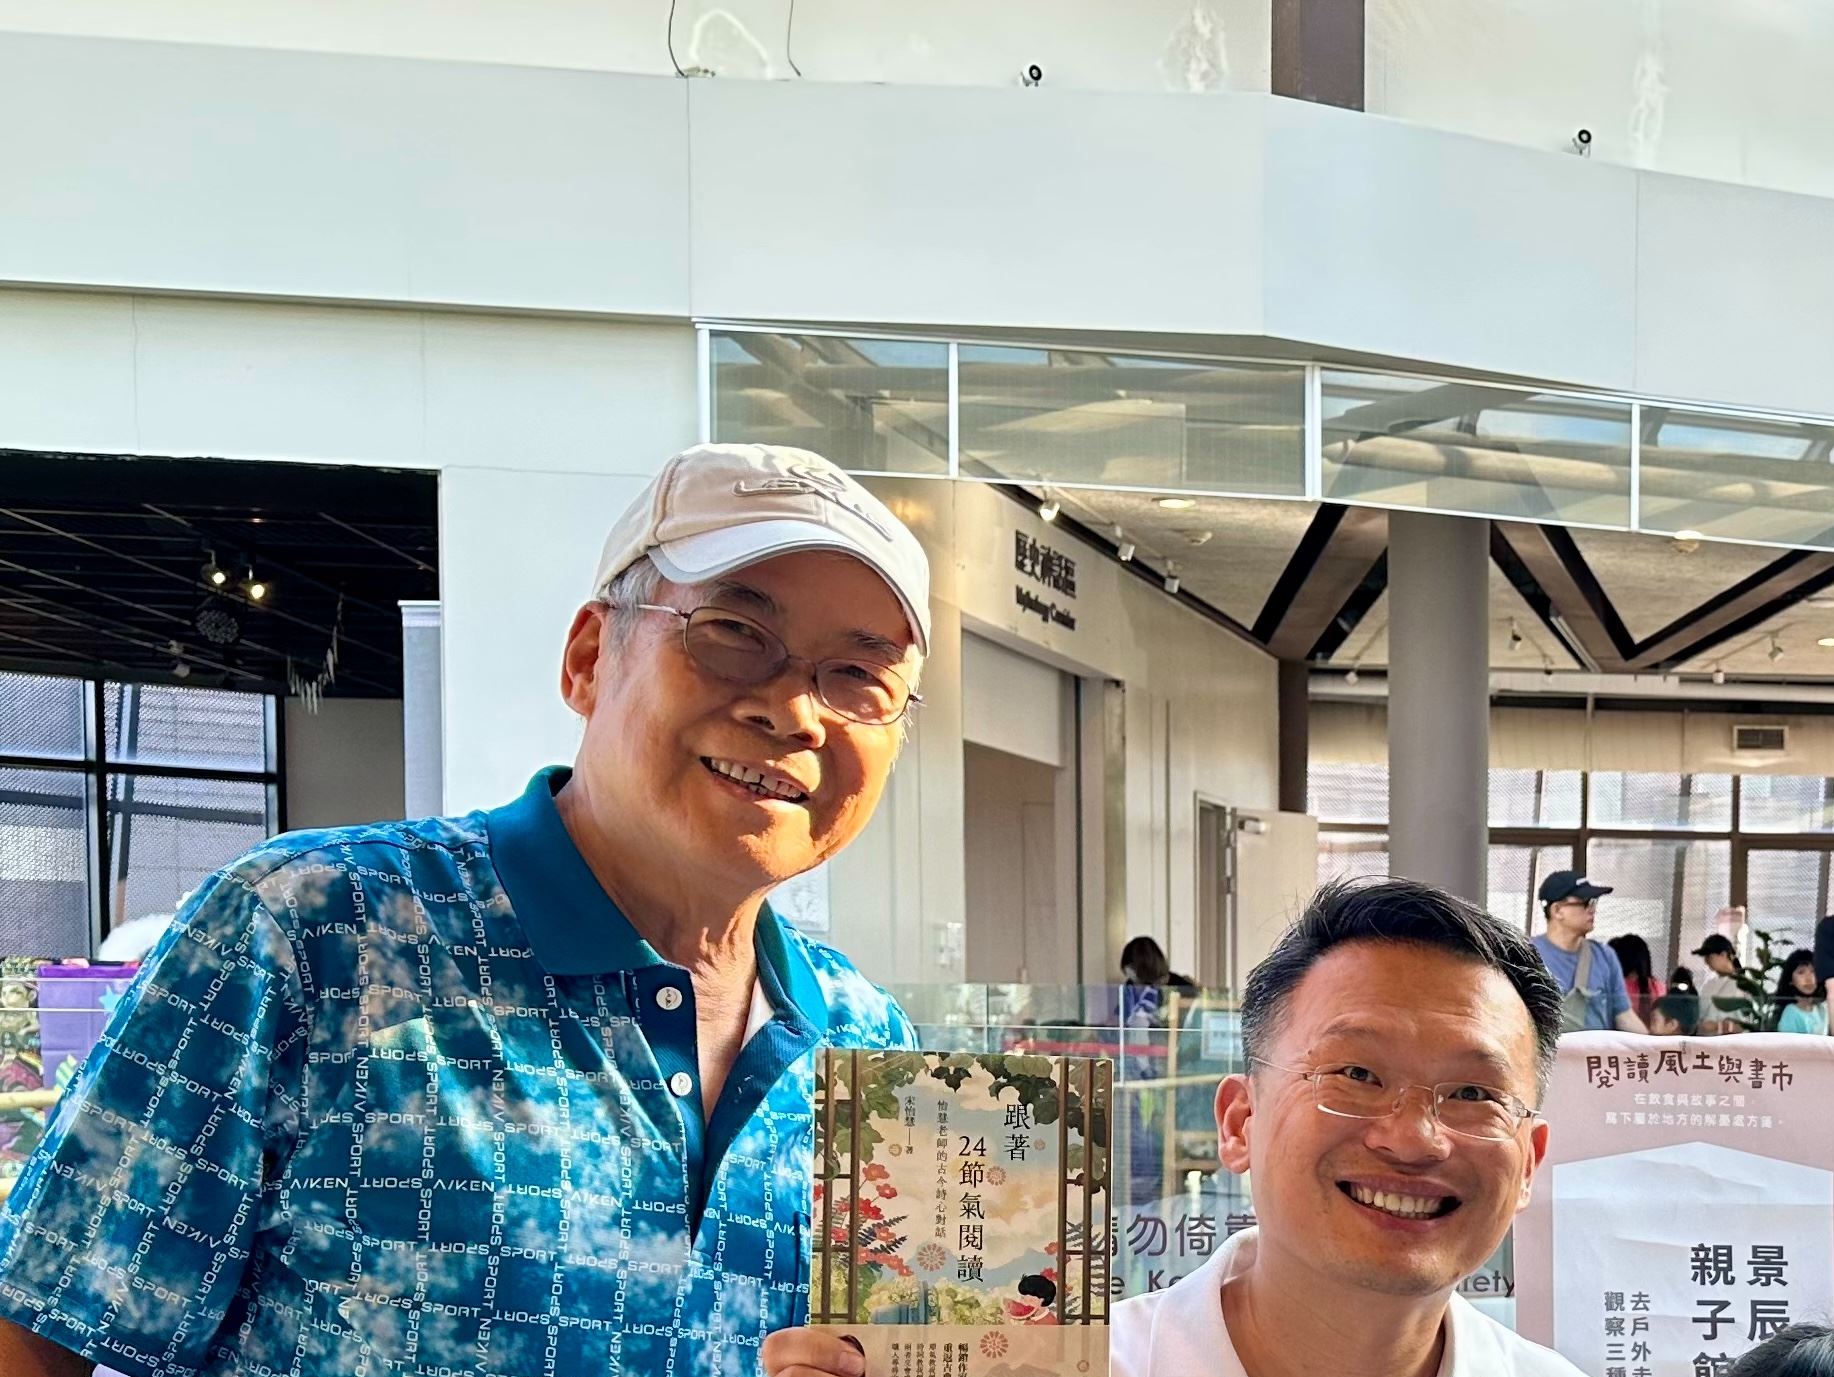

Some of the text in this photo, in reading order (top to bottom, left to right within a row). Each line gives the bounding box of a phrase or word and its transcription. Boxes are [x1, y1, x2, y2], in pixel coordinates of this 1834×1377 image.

[357, 866, 411, 884] SPORT
[349, 871, 366, 923] SPORT
[368, 924, 418, 944] SPORT
[470, 902, 487, 951] SPORT
[417, 943, 432, 996] SPORT
[479, 955, 493, 1005] SPORT
[146, 983, 196, 1013] SPORT
[200, 1013, 249, 1043] SPORT
[369, 1049, 428, 1061] SPORT
[437, 1056, 491, 1070] SPORT
[504, 1059, 557, 1077] SPORT
[1586, 1049, 1794, 1092] 閱讀風土與書市
[365, 1113, 425, 1125] SPORT
[437, 1117, 493, 1131] SPORT
[191, 1104, 226, 1157] SPORT
[1004, 1104, 1031, 1161] 跟著
[350, 1122, 363, 1177] SPORT
[424, 1126, 436, 1179] SPORT
[632, 1139, 681, 1154] SPORT
[729, 1153, 766, 1171] SPORT
[195, 1159, 250, 1190] SPORT
[360, 1177, 422, 1188] SPORT
[507, 1184, 561, 1198] SPORT
[957, 1136, 987, 1282] 24節氣閱讀
[429, 1240, 489, 1254] SPORT
[500, 1246, 557, 1261] SPORT
[628, 1262, 681, 1275] SPORT
[421, 1302, 480, 1320] SPORT
[493, 1311, 550, 1325] SPORT
